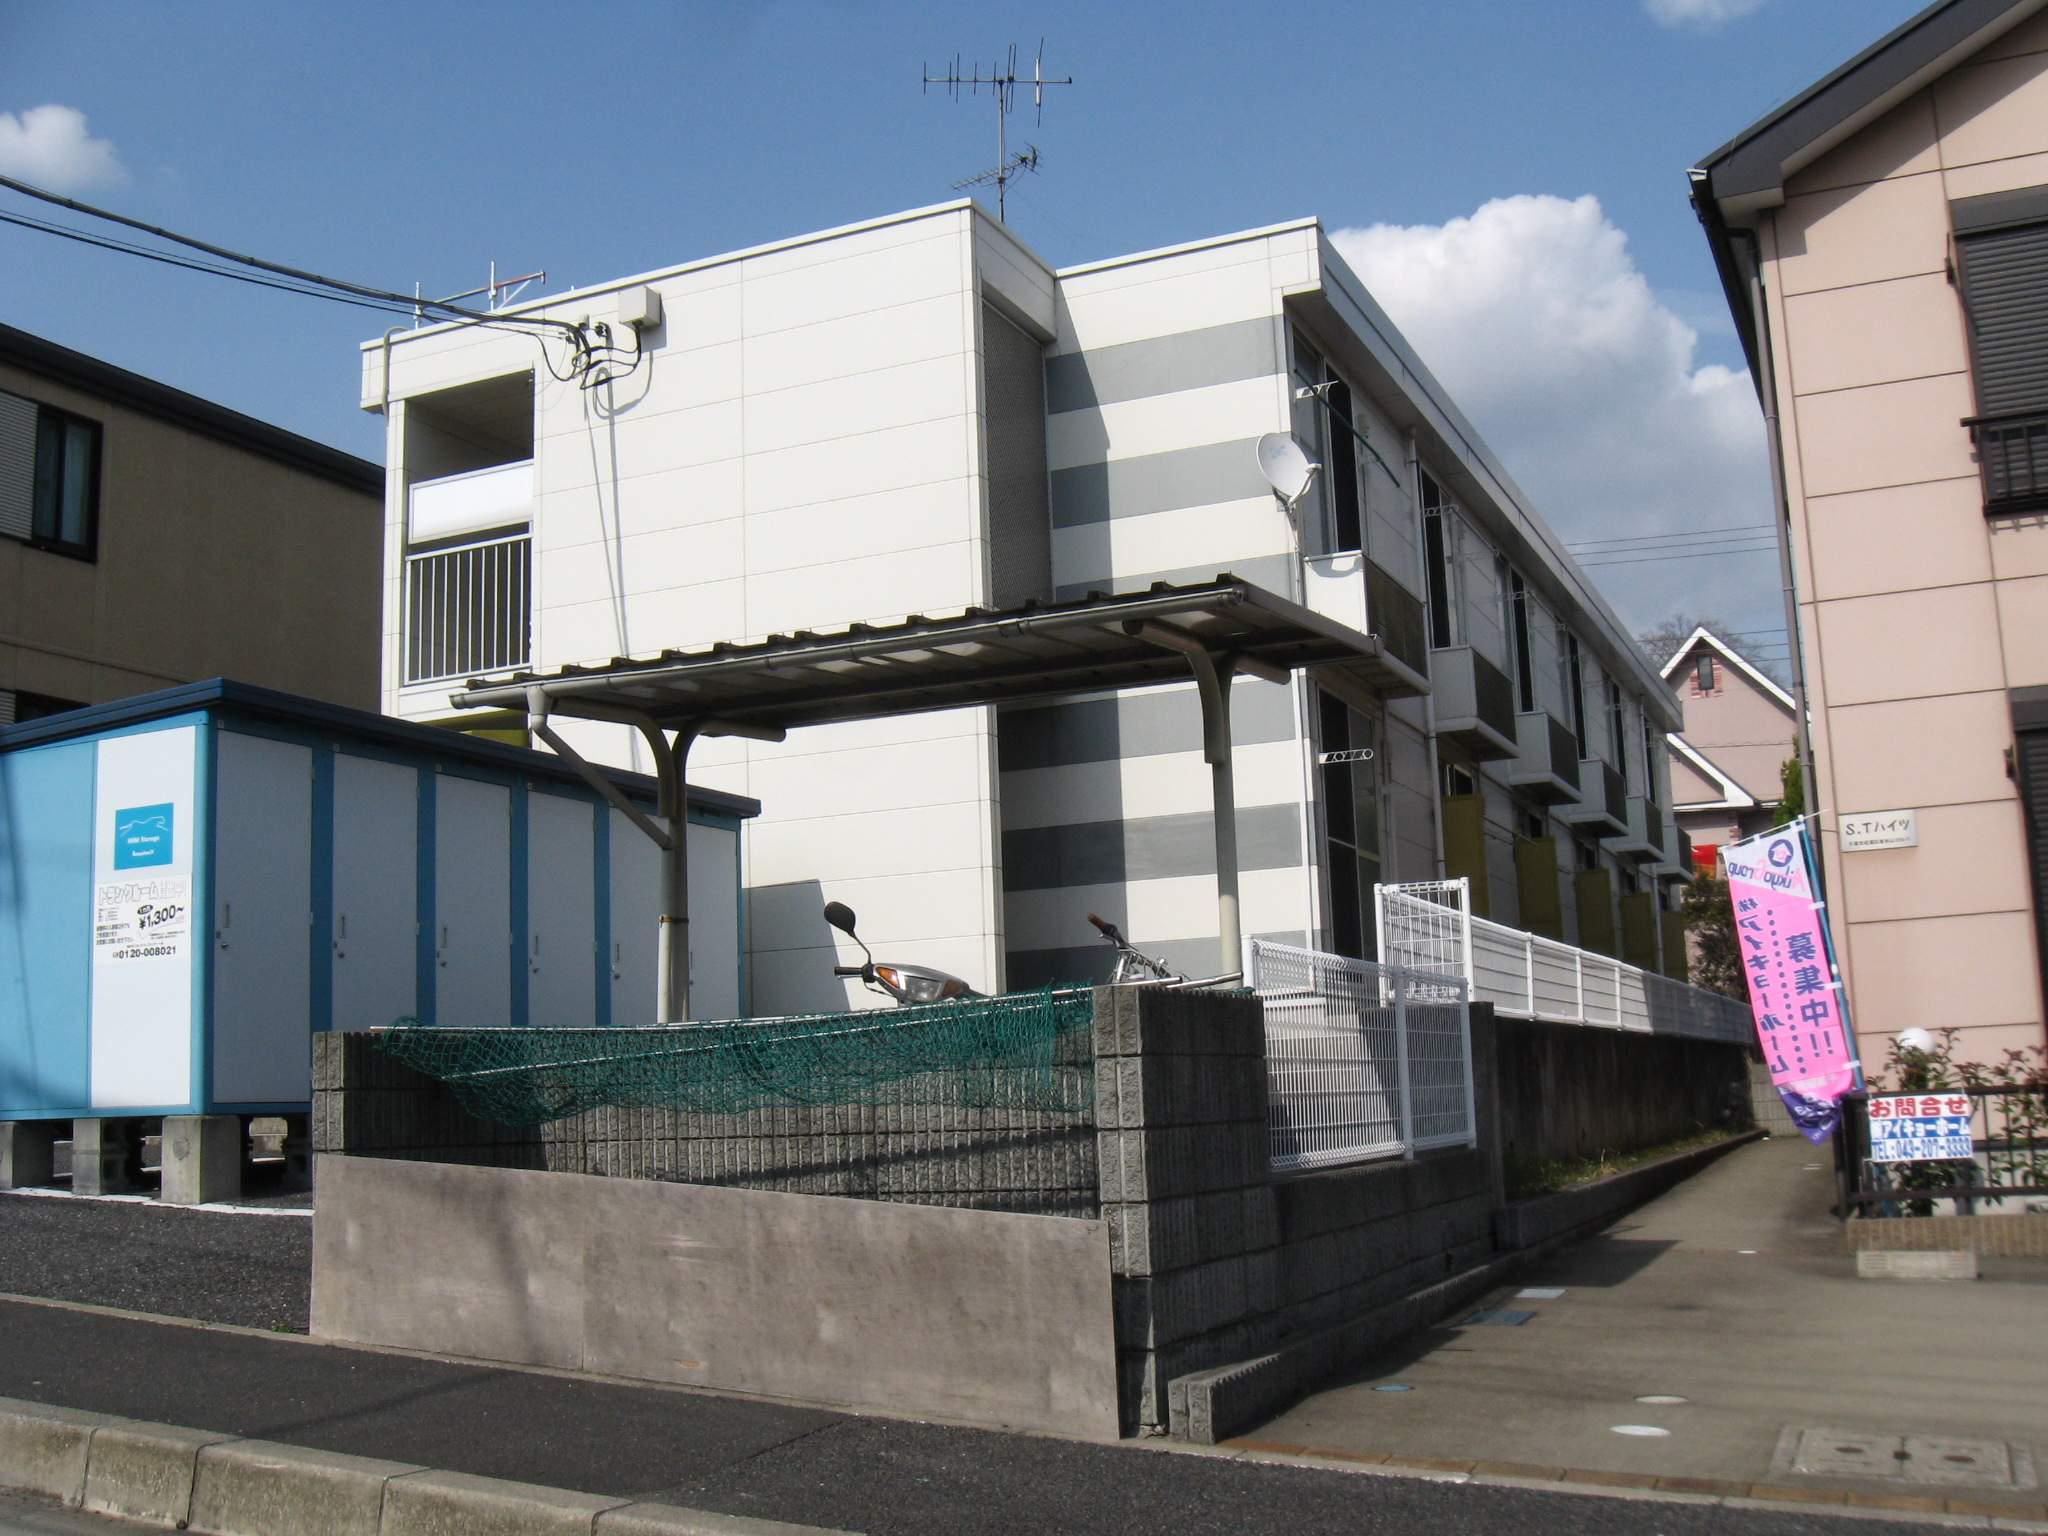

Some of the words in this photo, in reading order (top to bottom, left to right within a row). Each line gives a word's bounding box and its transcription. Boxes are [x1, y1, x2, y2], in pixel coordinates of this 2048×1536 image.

[1870, 1096, 1968, 1118] お問合せ
[1870, 1117, 1970, 1139] アイキョーホーム
